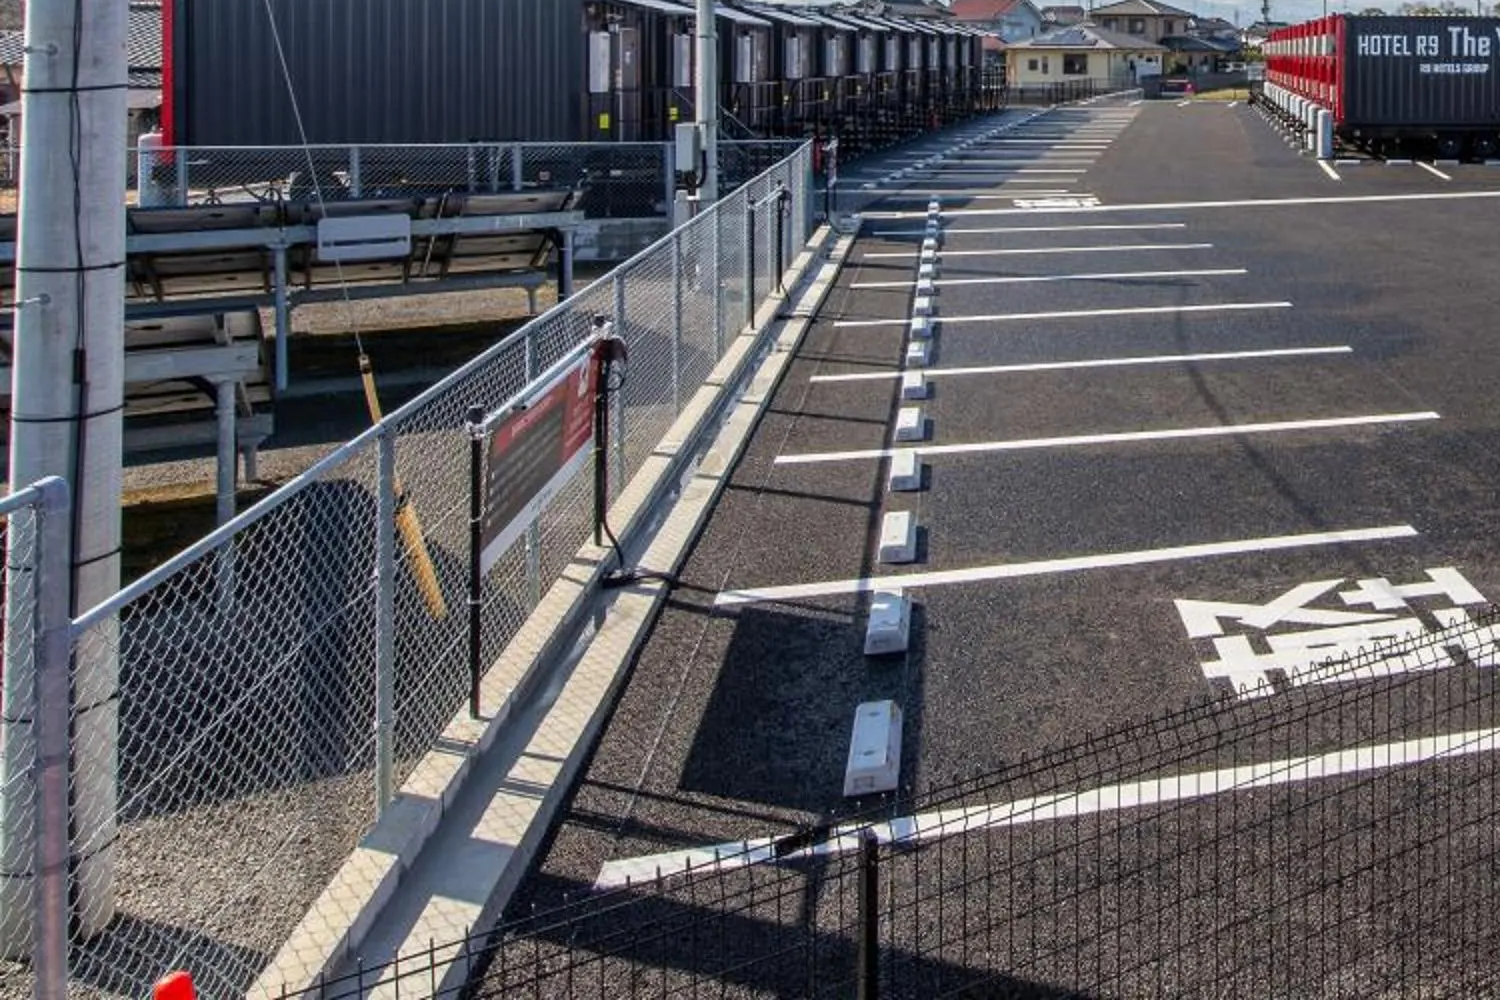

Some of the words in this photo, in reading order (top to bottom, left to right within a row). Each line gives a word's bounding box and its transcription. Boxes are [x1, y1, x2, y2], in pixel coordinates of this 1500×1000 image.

[1357, 35, 1411, 56] HOTEL
[1416, 35, 1439, 56] R9
[1448, 27, 1491, 57] The
